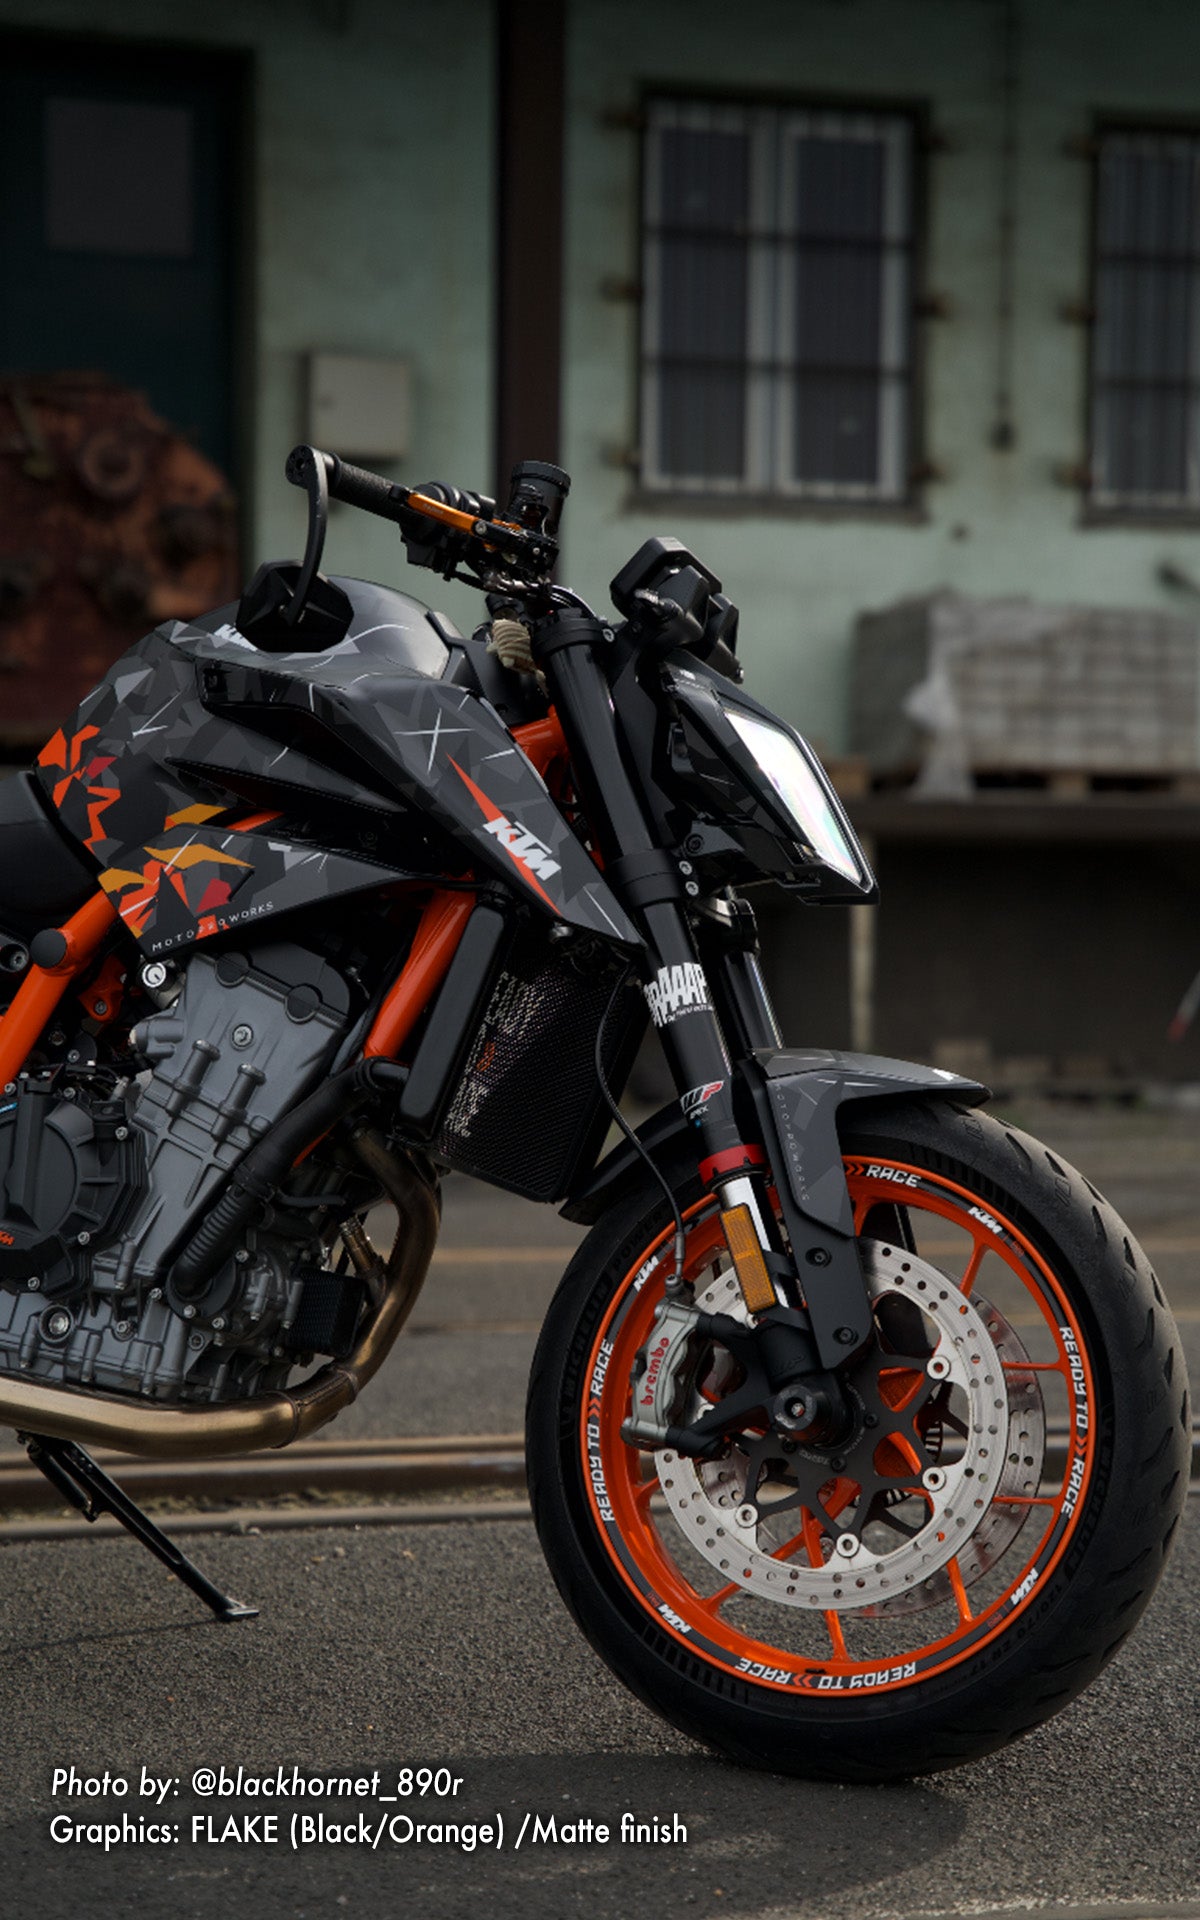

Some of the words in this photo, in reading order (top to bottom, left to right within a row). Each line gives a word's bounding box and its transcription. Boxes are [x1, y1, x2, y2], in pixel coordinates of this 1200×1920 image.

[482, 815, 562, 881] KTM
[680, 1080, 724, 1115] WP
[865, 1164, 922, 1188] RACE
[968, 1206, 1003, 1234] KTM
[633, 1255, 659, 1292] KTM
[590, 1338, 614, 1397] RACE
[640, 1337, 669, 1406] brembo
[1059, 1326, 1088, 1396] READY
[1076, 1401, 1089, 1429] TO
[587, 1423, 600, 1450] TO
[588, 1454, 616, 1522] READY
[1060, 1458, 1085, 1519] RACE
[1010, 1567, 1039, 1605] KTM
[657, 1603, 692, 1633] KTM
[735, 1658, 792, 1685] RACE
[817, 1676, 844, 1690] TO
[849, 1661, 917, 1690] READY
